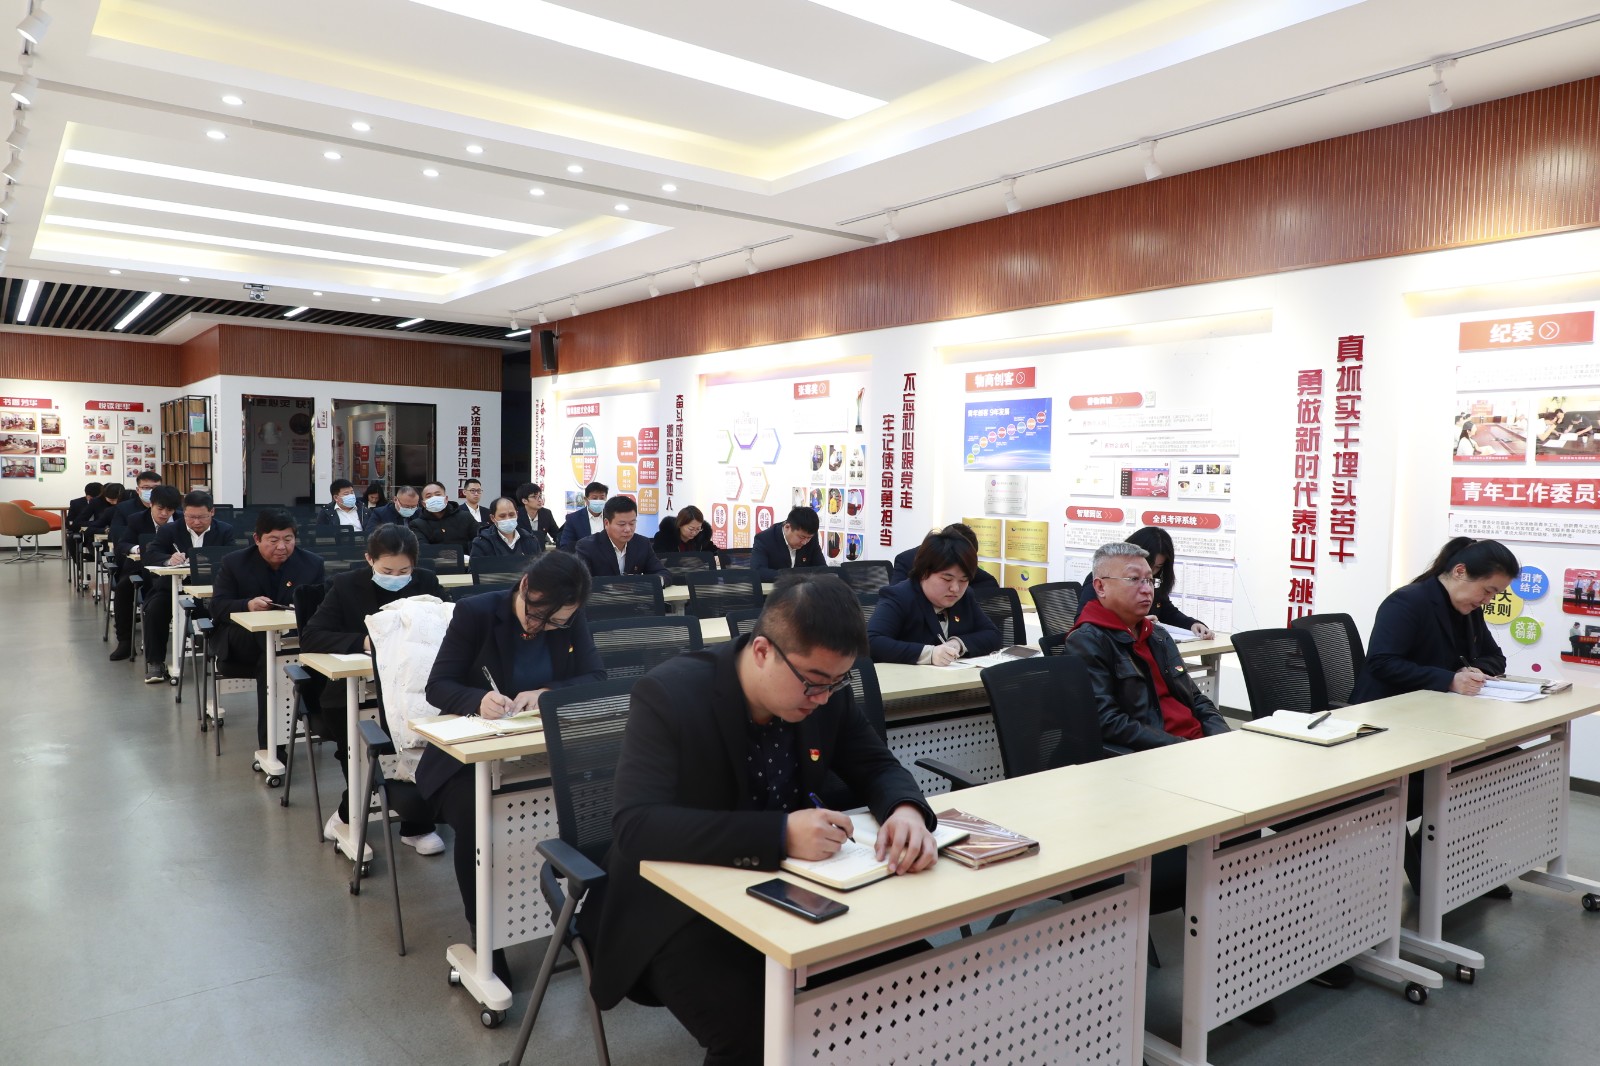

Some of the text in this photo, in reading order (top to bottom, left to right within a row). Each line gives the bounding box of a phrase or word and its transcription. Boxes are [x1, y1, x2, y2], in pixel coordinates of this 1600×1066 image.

[1489, 321, 1534, 343] 纪委
[975, 372, 1014, 388] 物商创客
[471, 405, 481, 478] 交流思想与感情
[676, 394, 684, 480] 奋斗成就自己
[900, 372, 917, 509] 不忘初心跟党走
[1329, 334, 1365, 563] 真抓实干埋头苦干
[666, 424, 674, 511] 激励成就他人
[880, 413, 895, 547] 牢记使命勇担当
[1461, 481, 1600, 504] 青年工作委员
[1076, 509, 1103, 519] 智慧园区
[1152, 514, 1197, 526] 全员考评系统
[1520, 572, 1543, 584] 团青
[1491, 590, 1512, 603] 大
[1520, 583, 1542, 594] 结合
[1483, 603, 1512, 617] 原则
[1516, 621, 1538, 630] 改革
[1515, 629, 1537, 640] 创新
